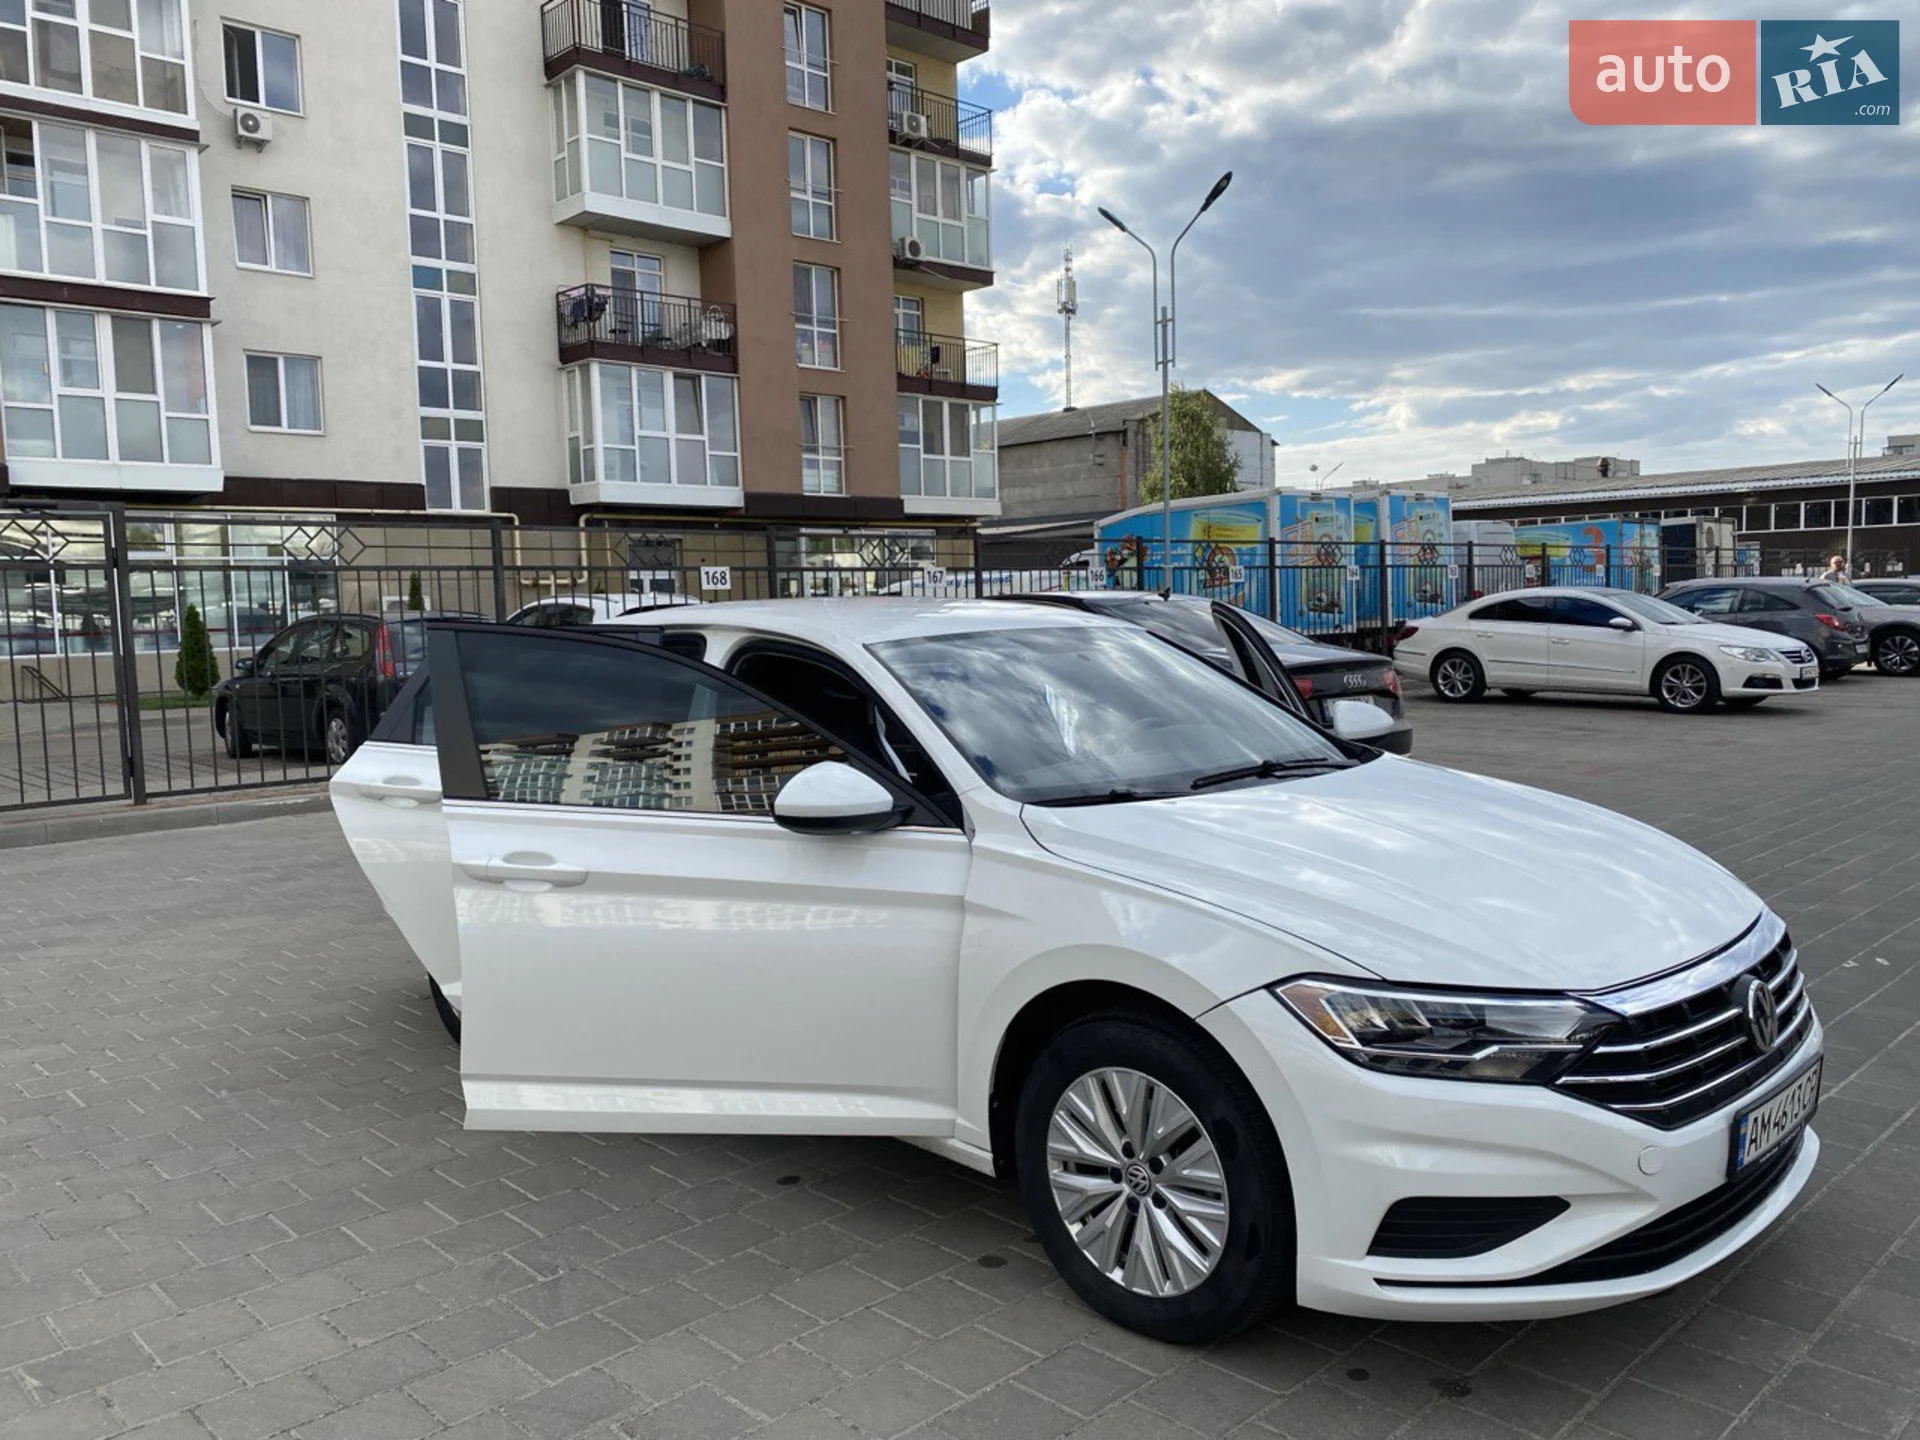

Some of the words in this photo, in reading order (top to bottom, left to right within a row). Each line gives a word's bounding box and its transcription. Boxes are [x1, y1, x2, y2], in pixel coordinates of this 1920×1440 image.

[704, 570, 728, 586] 168
[926, 570, 944, 584] 167
[1089, 569, 1105, 582] 166
[1230, 568, 1243, 580] 165
